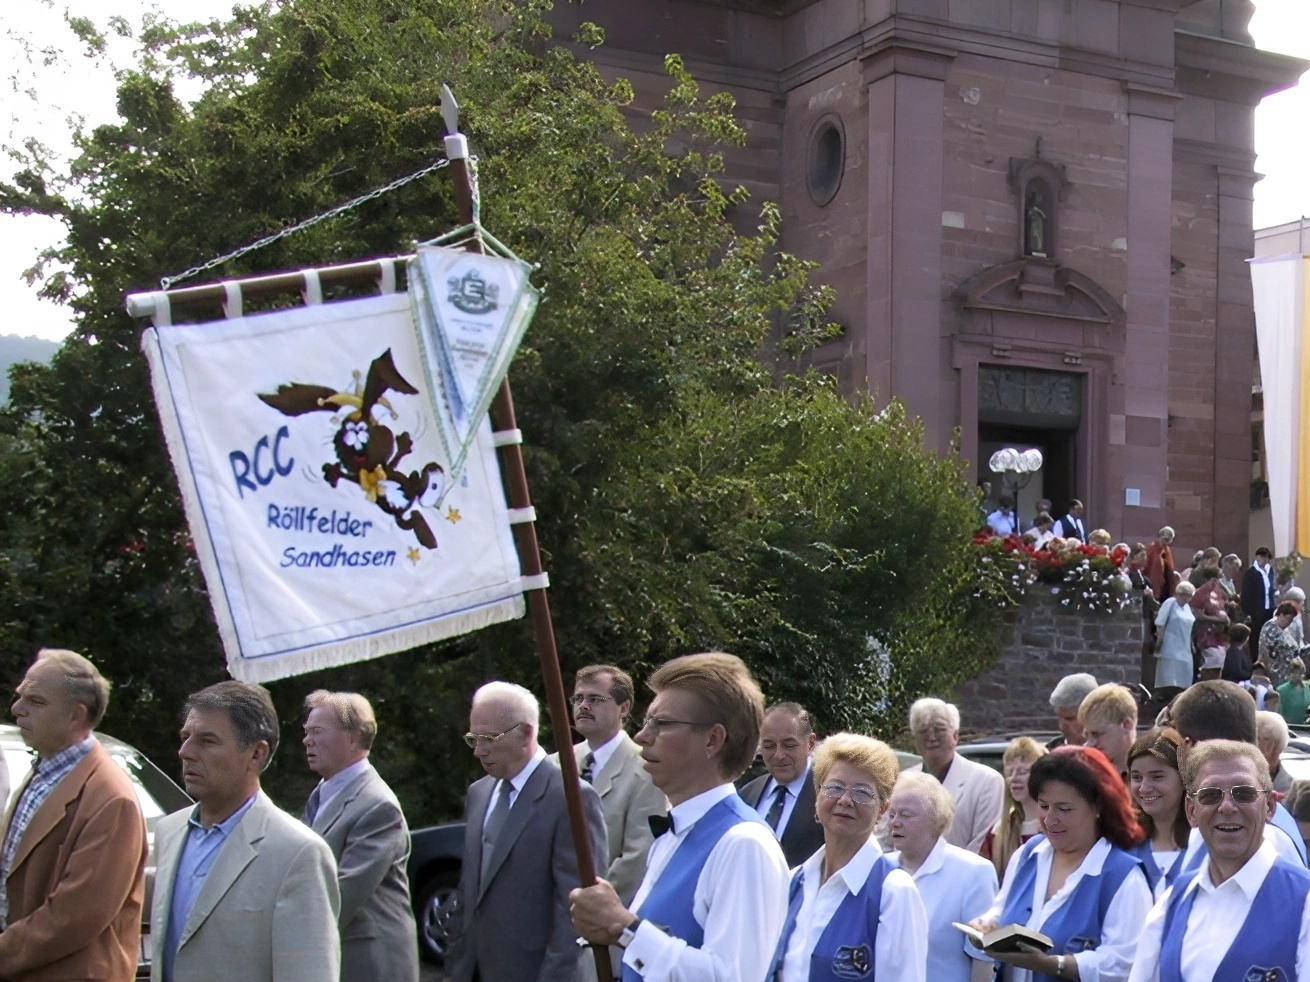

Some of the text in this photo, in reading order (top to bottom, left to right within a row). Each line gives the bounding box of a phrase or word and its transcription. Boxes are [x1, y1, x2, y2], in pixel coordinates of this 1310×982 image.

[229, 425, 295, 500] RCC
[267, 503, 373, 538] Röllfelder
[279, 543, 397, 568] Sandhasen
